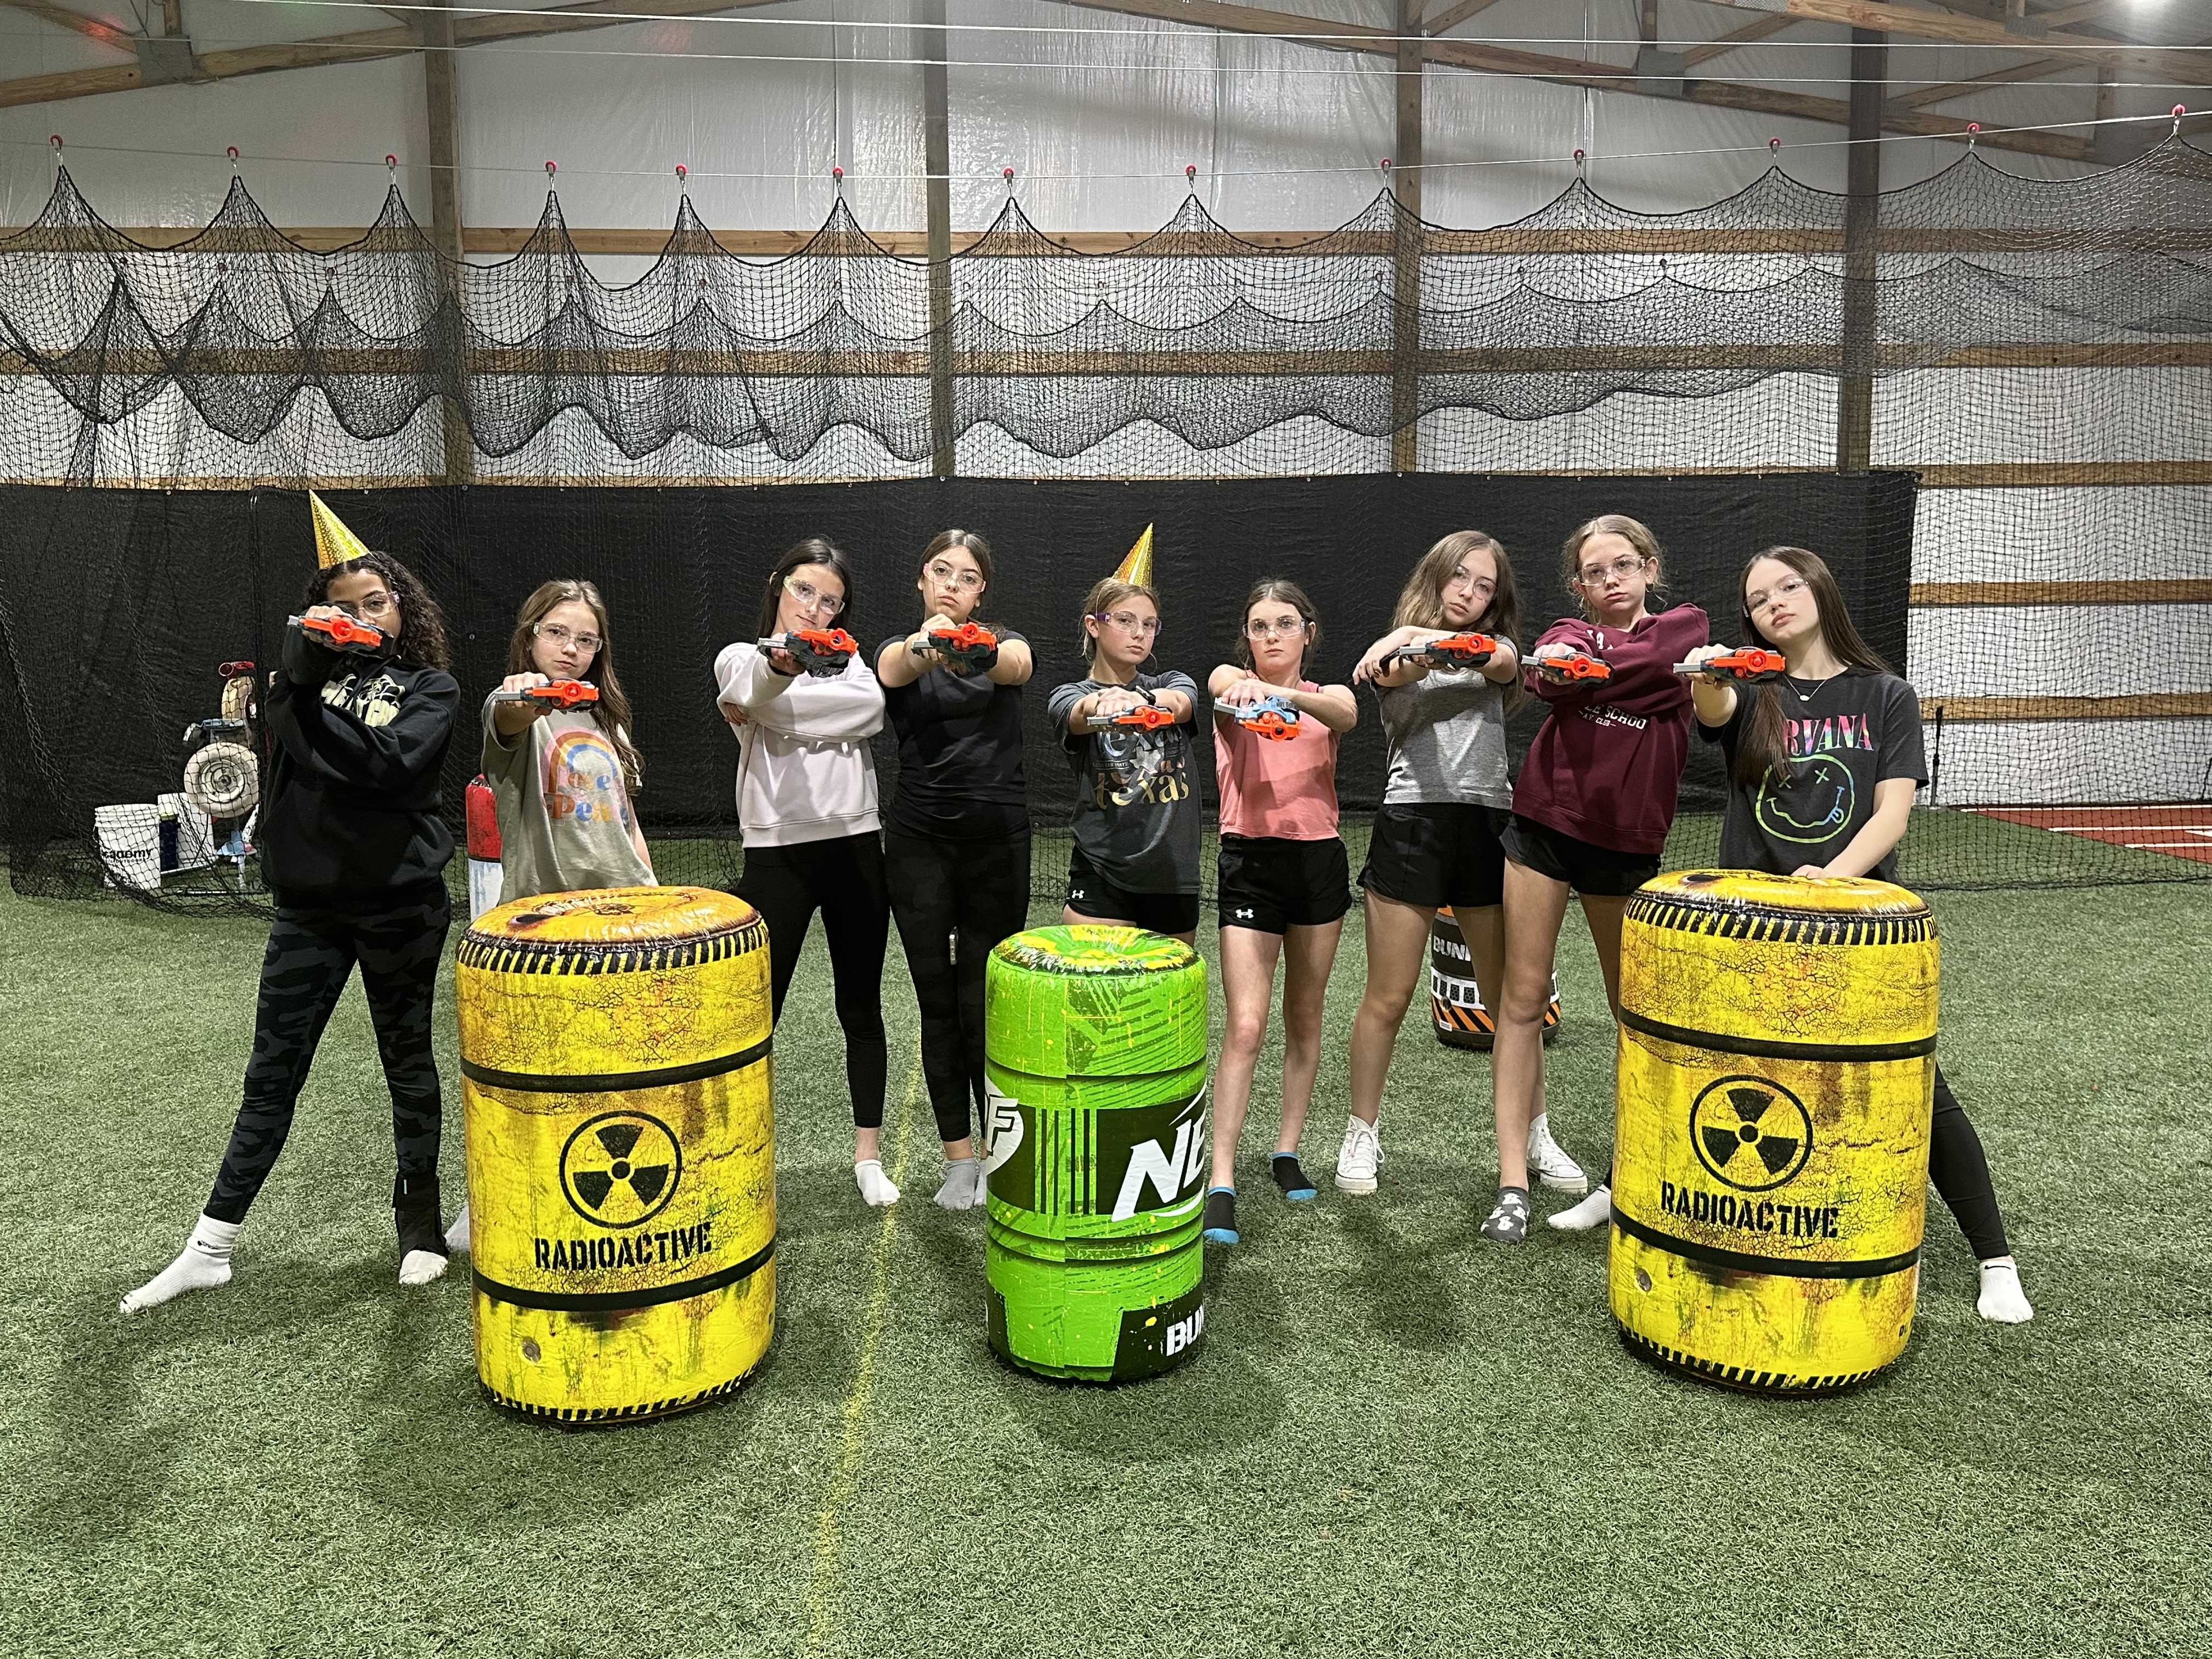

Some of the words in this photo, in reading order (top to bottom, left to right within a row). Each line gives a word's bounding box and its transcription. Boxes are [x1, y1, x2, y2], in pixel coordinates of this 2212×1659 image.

[1605, 706, 1648, 731] SCHOO
[1783, 713, 1874, 756] RVANA
[1094, 772, 1189, 810] texas
[1661, 1180, 1838, 1238] RADIOACTIVE
[534, 1221, 712, 1270] RADIOACTIVE
